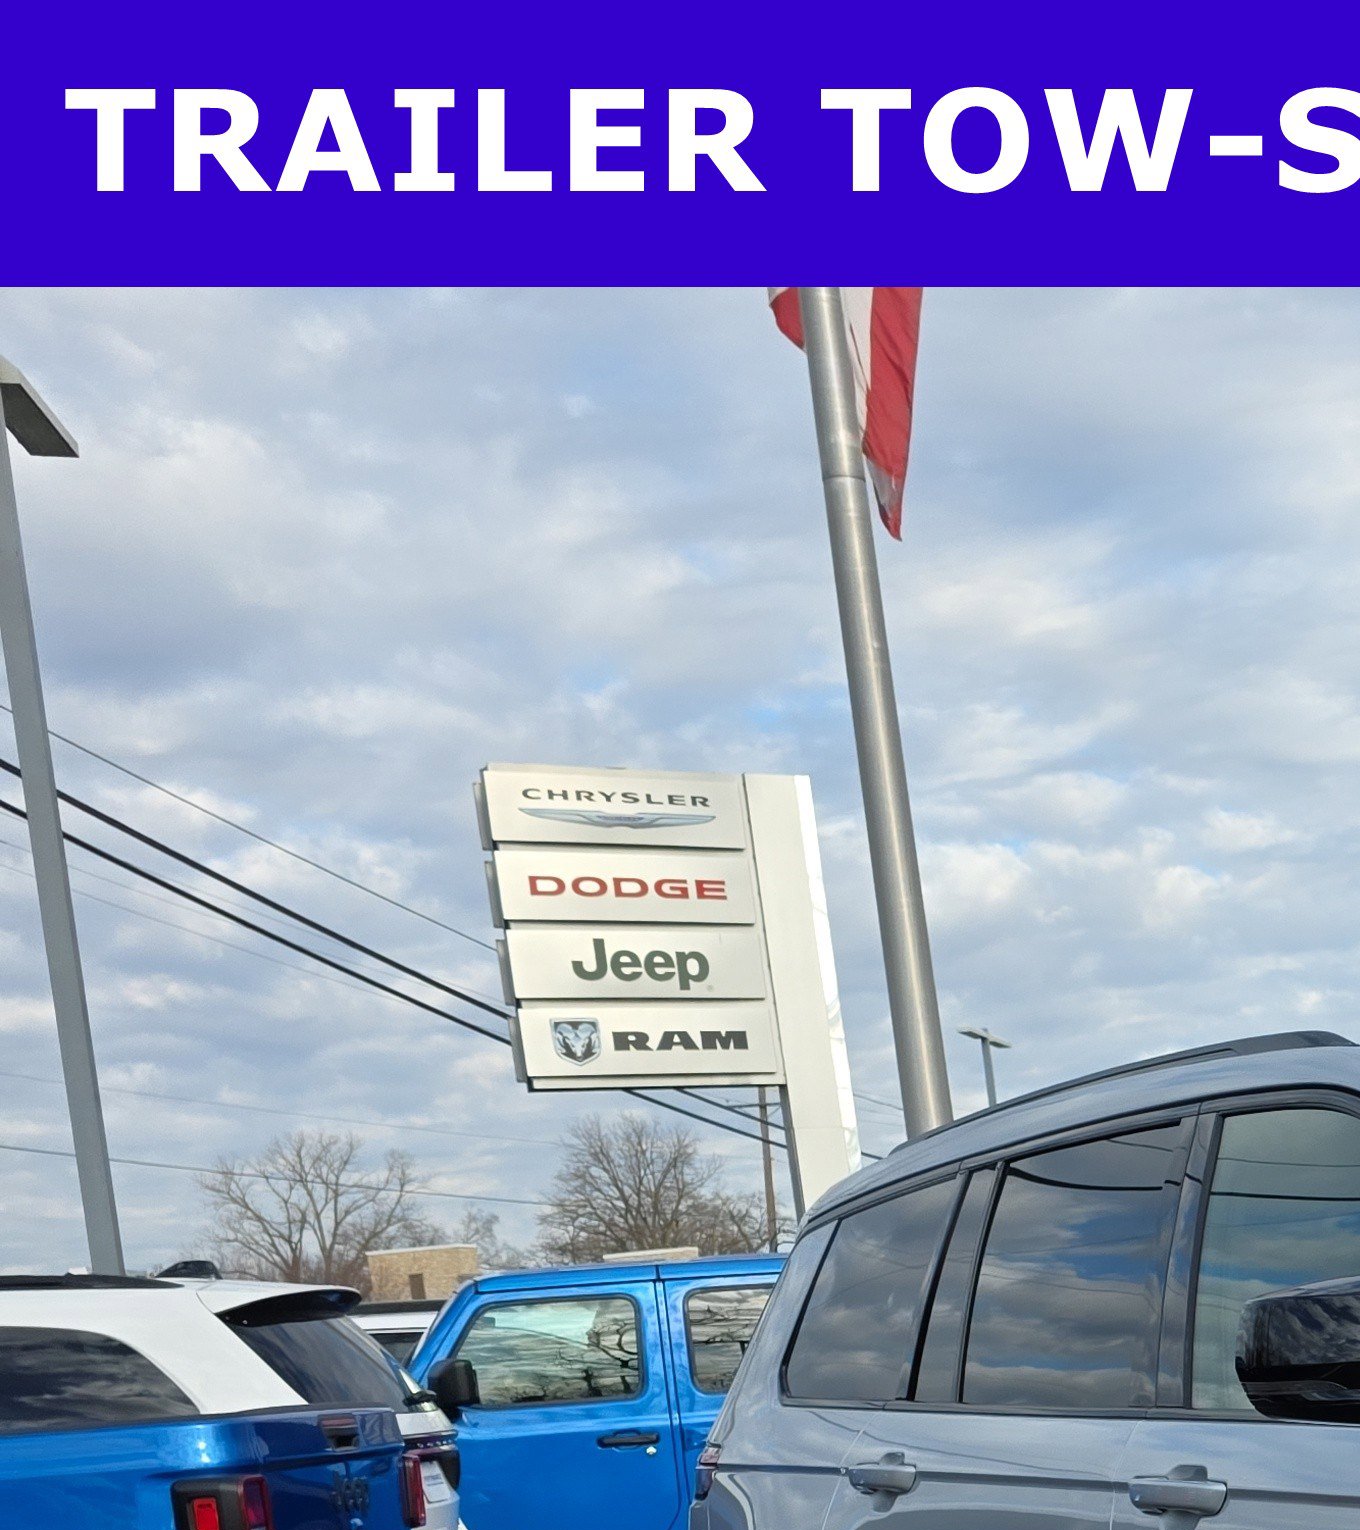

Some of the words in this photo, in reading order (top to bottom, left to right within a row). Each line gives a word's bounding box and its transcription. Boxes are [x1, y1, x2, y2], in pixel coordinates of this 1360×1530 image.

[522, 788, 710, 808] CHRYSLER
[527, 875, 728, 900] DODGE
[571, 938, 710, 991] Jeep
[612, 1030, 749, 1051] RAM
